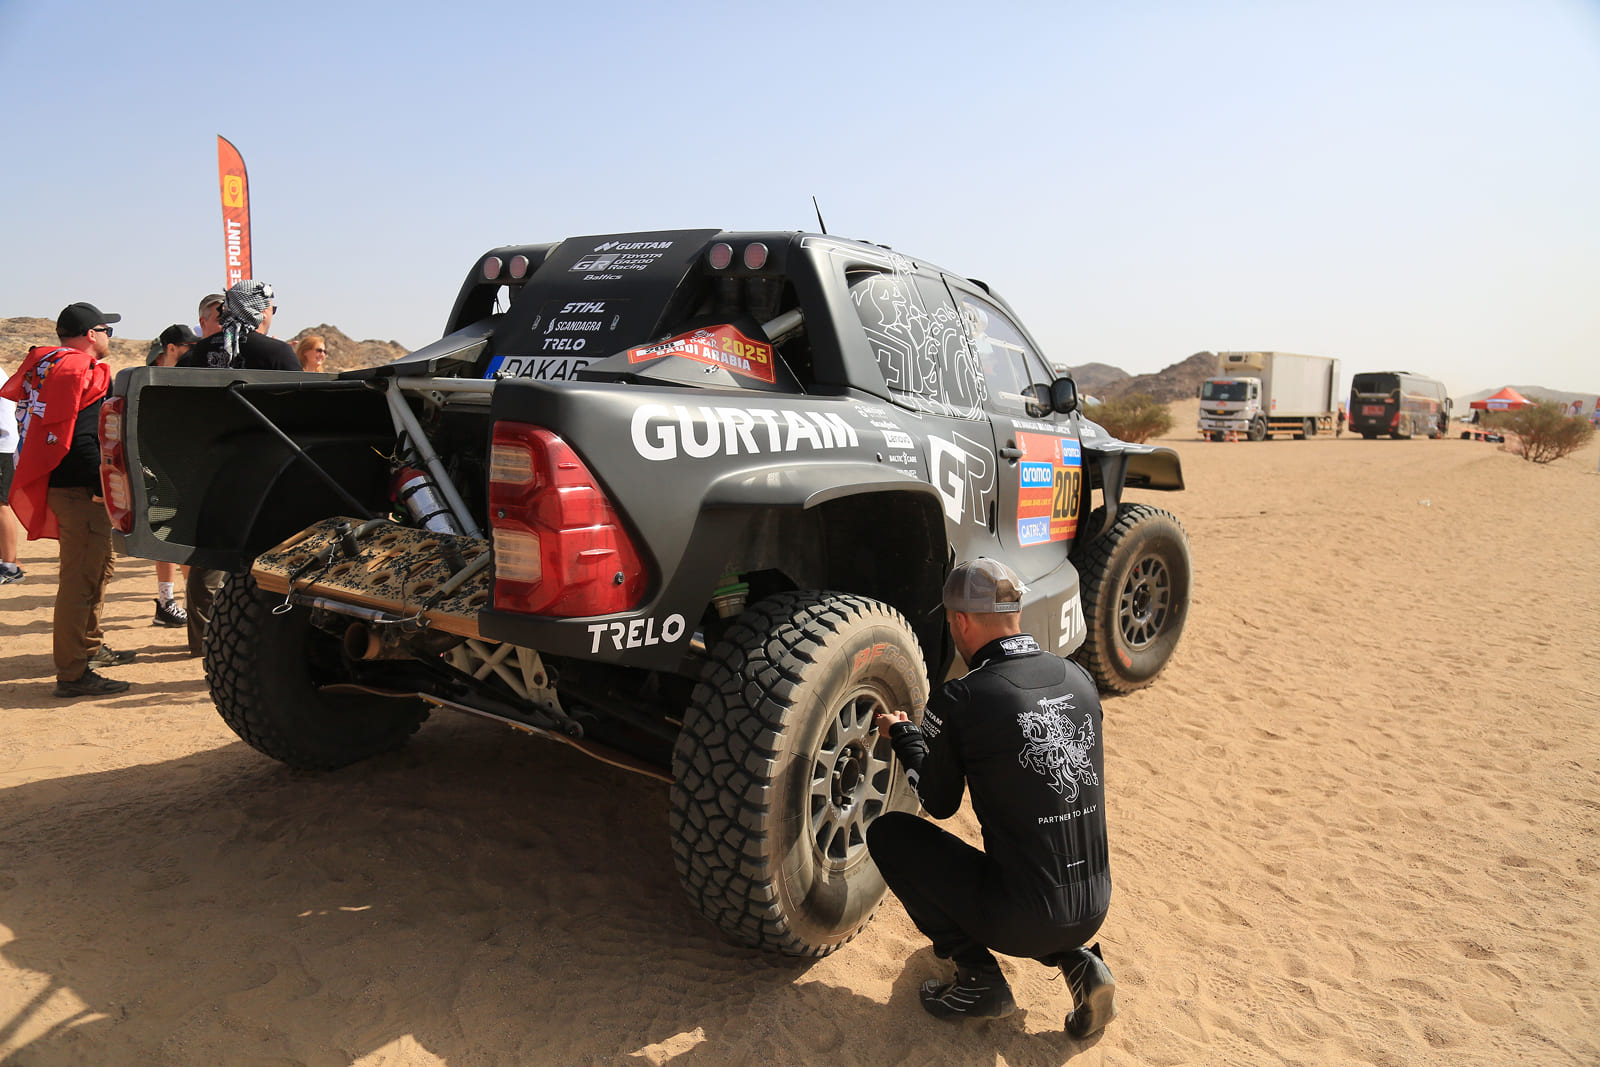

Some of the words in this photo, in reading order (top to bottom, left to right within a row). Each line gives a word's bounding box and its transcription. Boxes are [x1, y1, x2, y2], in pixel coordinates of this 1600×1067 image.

[227, 218, 242, 267] POINT
[615, 241, 673, 250] GURTAM
[560, 302, 606, 314] STIHL
[555, 321, 602, 331] SCANDAGRA
[542, 338, 587, 351] TRELO
[656, 343, 699, 356] SAUDI
[702, 346, 751, 371] ARABIA
[721, 336, 768, 364] 2025
[630, 403, 859, 461] GURTAM
[927, 430, 996, 527] GR
[1022, 467, 1052, 483] aramco
[1052, 470, 1081, 519] 208
[587, 613, 686, 654] TRELO
[1072, 810, 1081, 819] TO
[1083, 804, 1097, 816] ALLY
